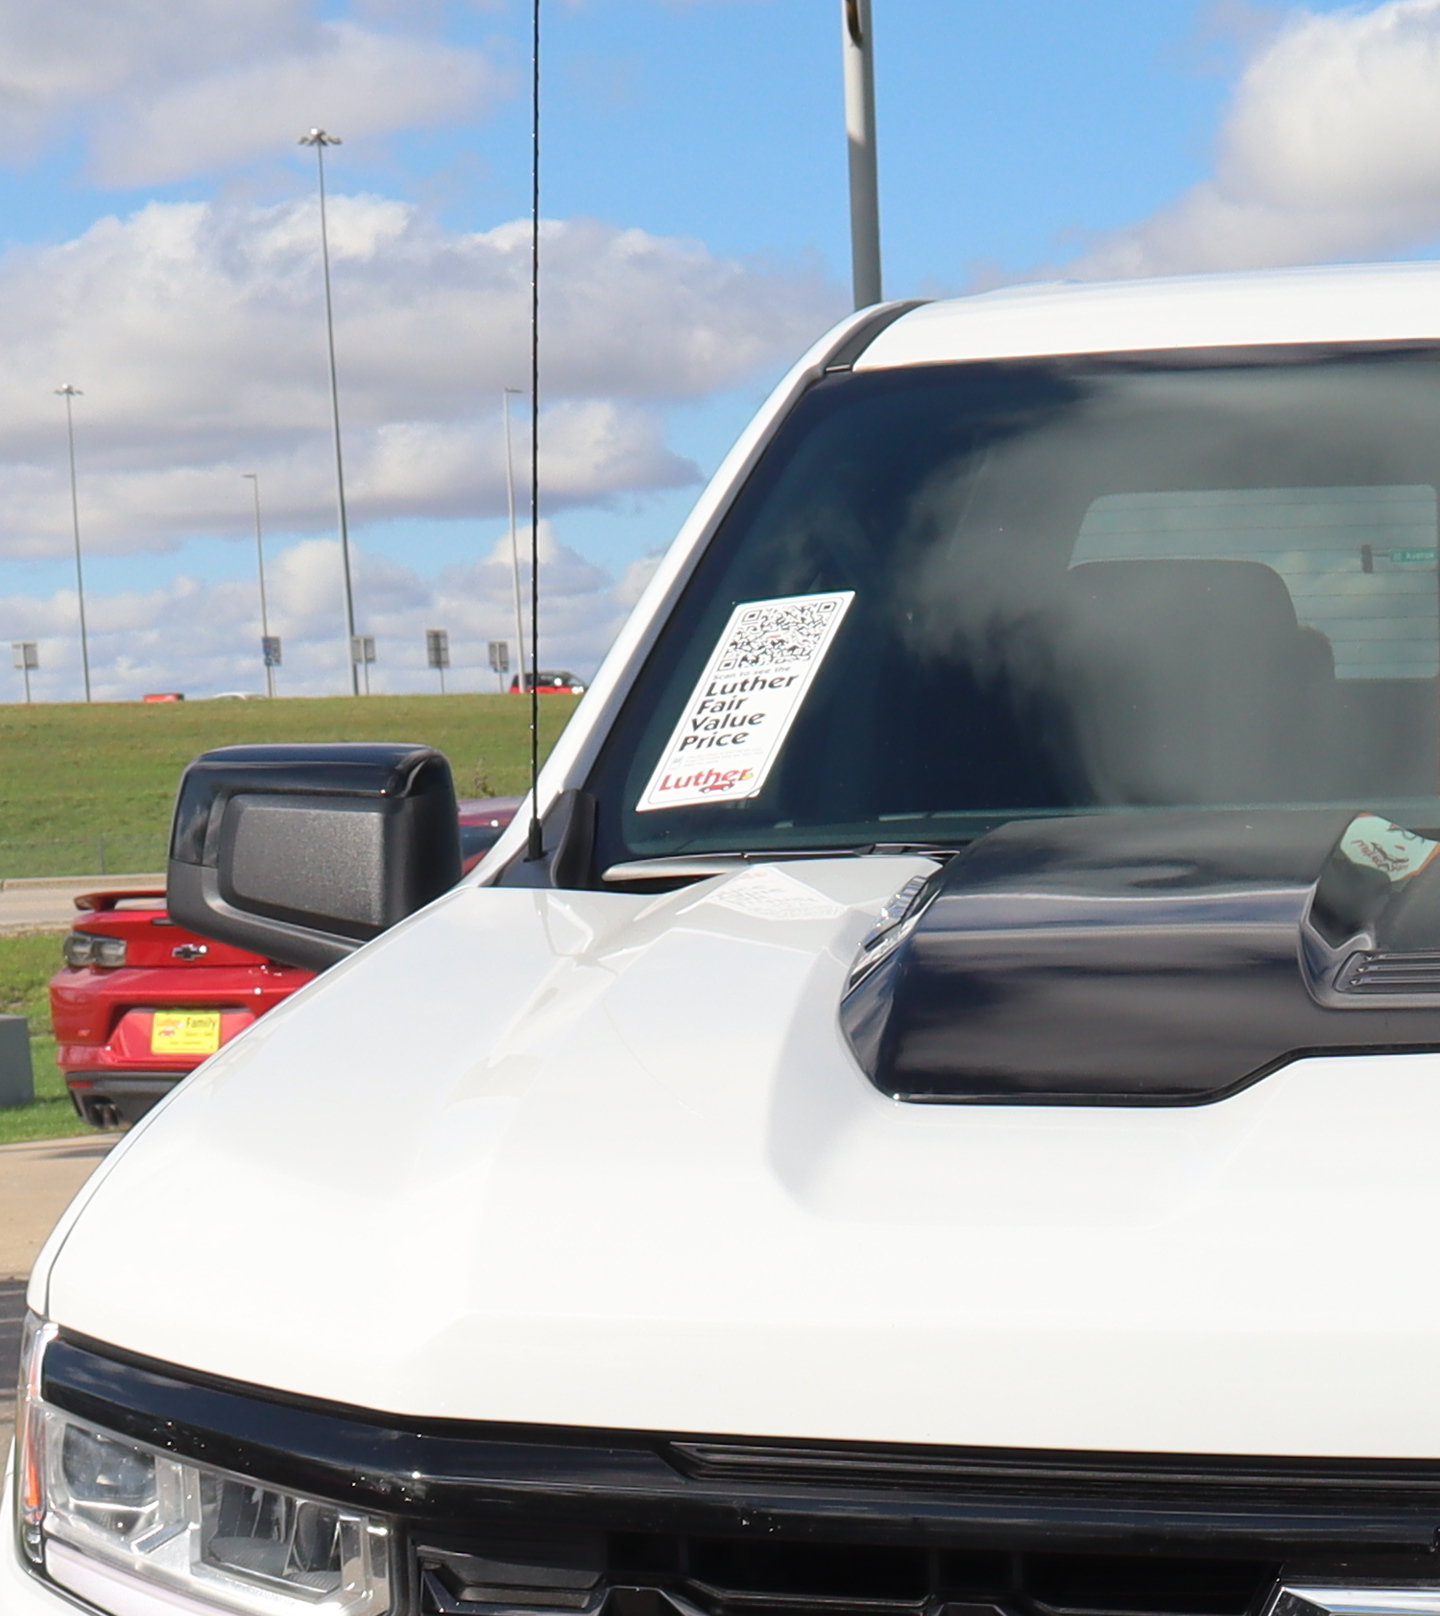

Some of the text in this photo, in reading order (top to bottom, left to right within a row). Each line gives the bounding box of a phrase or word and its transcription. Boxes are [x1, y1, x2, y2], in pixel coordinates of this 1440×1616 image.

[704, 674, 801, 698] Luther
[696, 695, 749, 716] Fair
[690, 711, 767, 734] Value
[678, 730, 751, 752] Price
[658, 766, 753, 792] Luther
